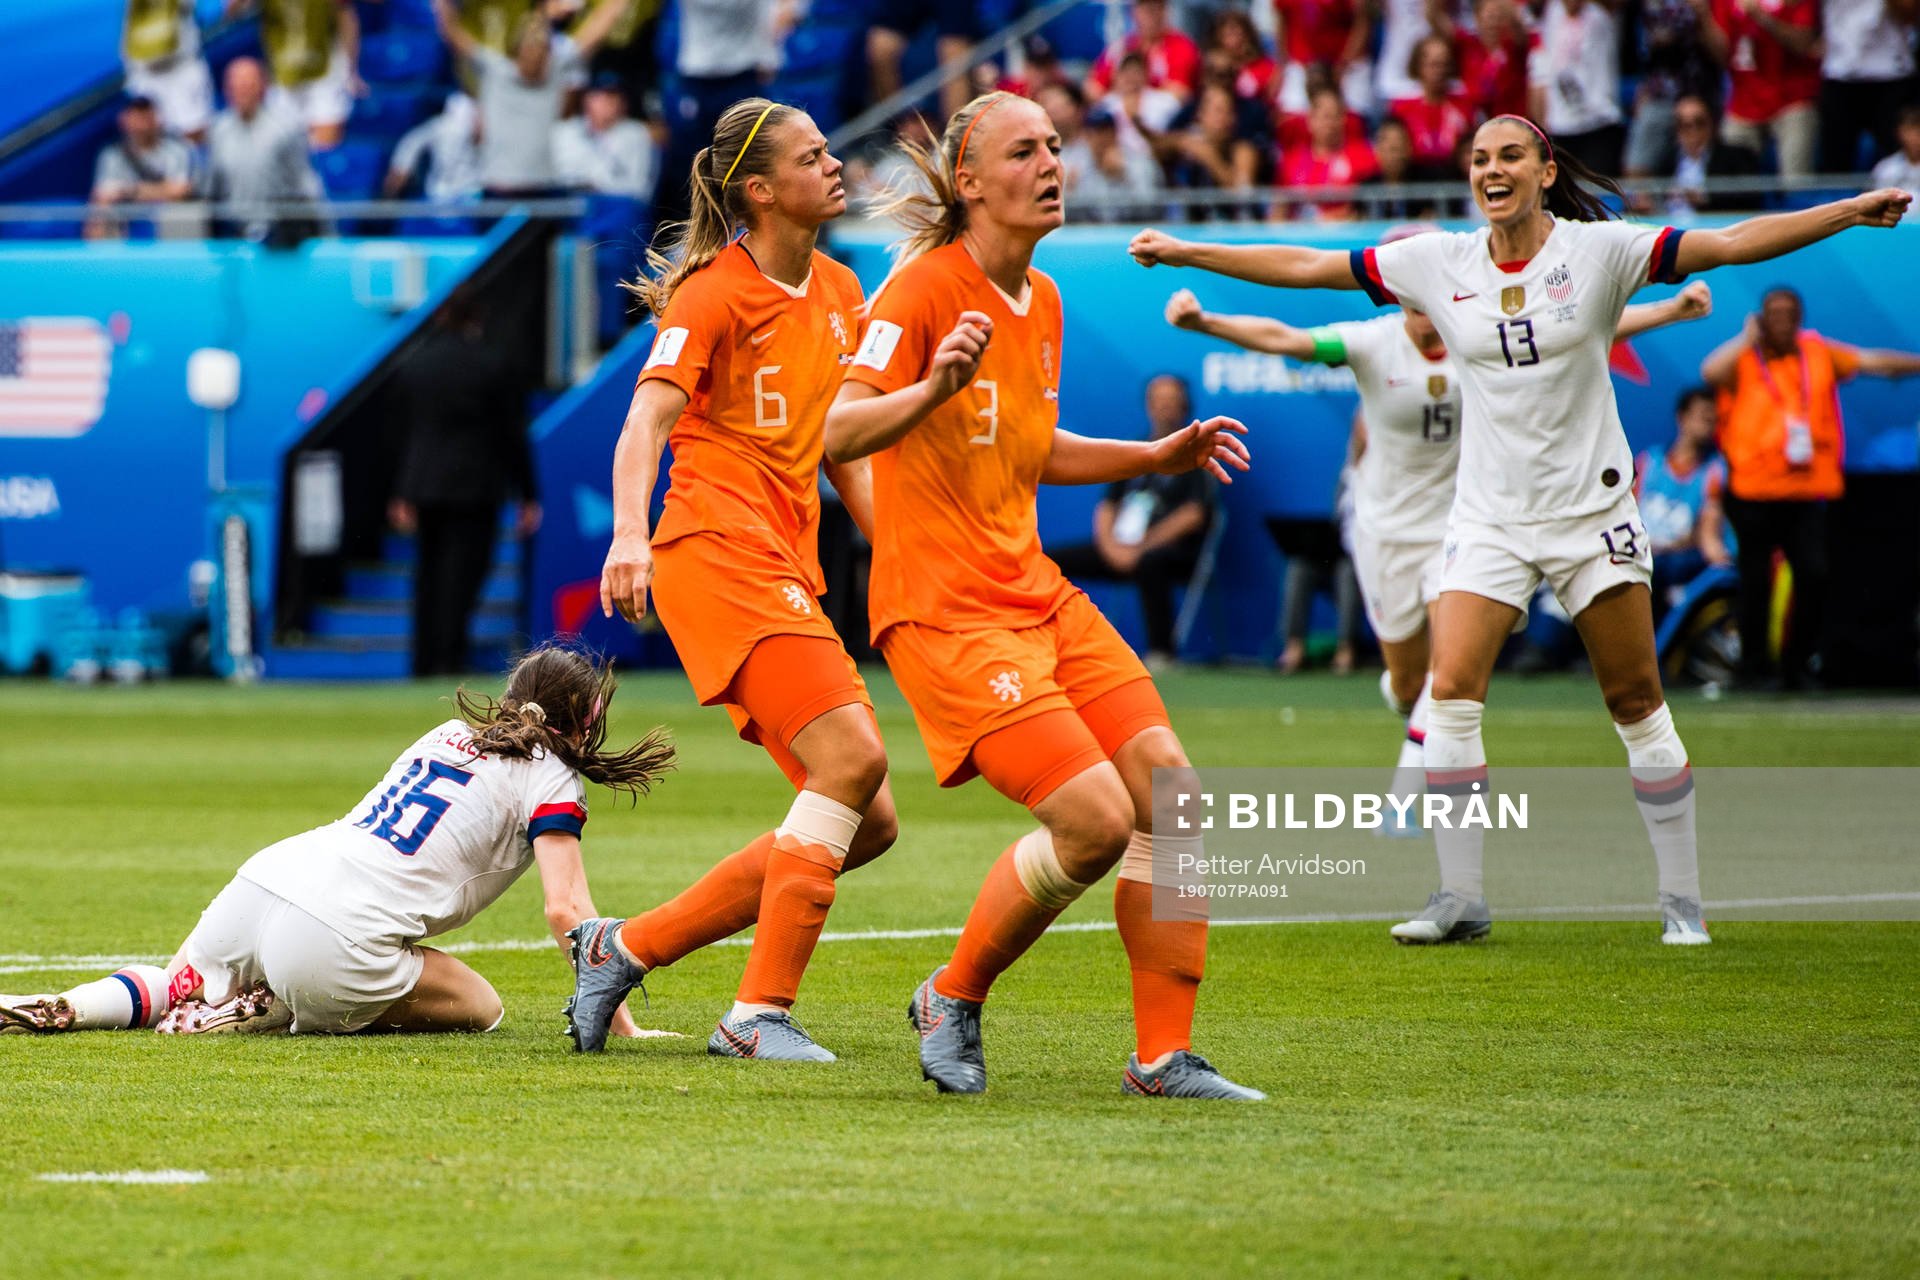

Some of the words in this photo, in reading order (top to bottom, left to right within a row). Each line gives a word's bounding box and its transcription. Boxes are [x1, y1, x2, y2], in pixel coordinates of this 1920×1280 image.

[1547, 271, 1568, 286] USA
[1497, 320, 1540, 367] 13
[753, 365, 787, 427] 6
[969, 379, 998, 445] 3
[1422, 403, 1453, 442] 15
[1600, 522, 1638, 558] 13
[352, 758, 474, 856] 16
